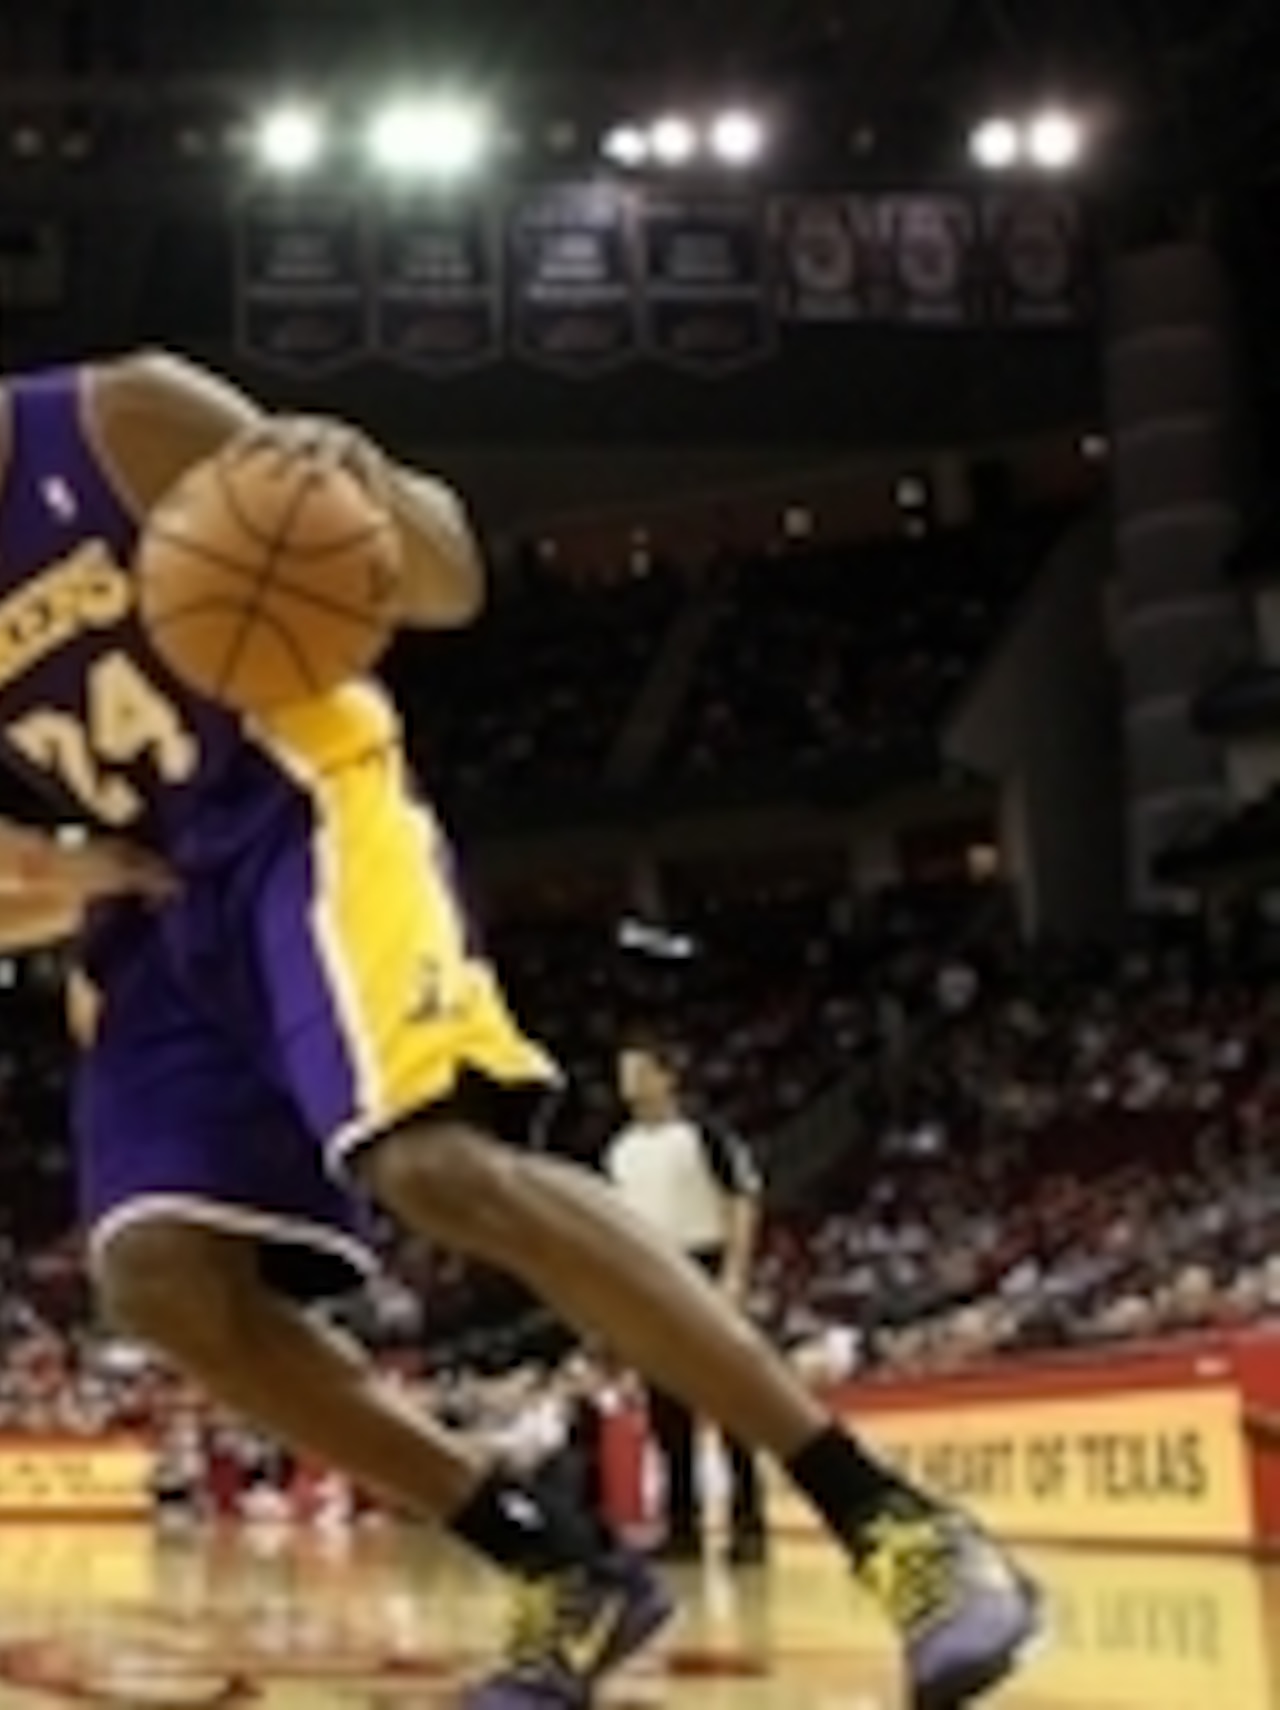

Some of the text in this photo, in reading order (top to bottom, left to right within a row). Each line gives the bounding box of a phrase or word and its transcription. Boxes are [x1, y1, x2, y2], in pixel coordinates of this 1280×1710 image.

[7, 650, 199, 823] 24
[1025, 1432, 1067, 1500] OF
[1075, 1428, 1207, 1498] TEXAS
